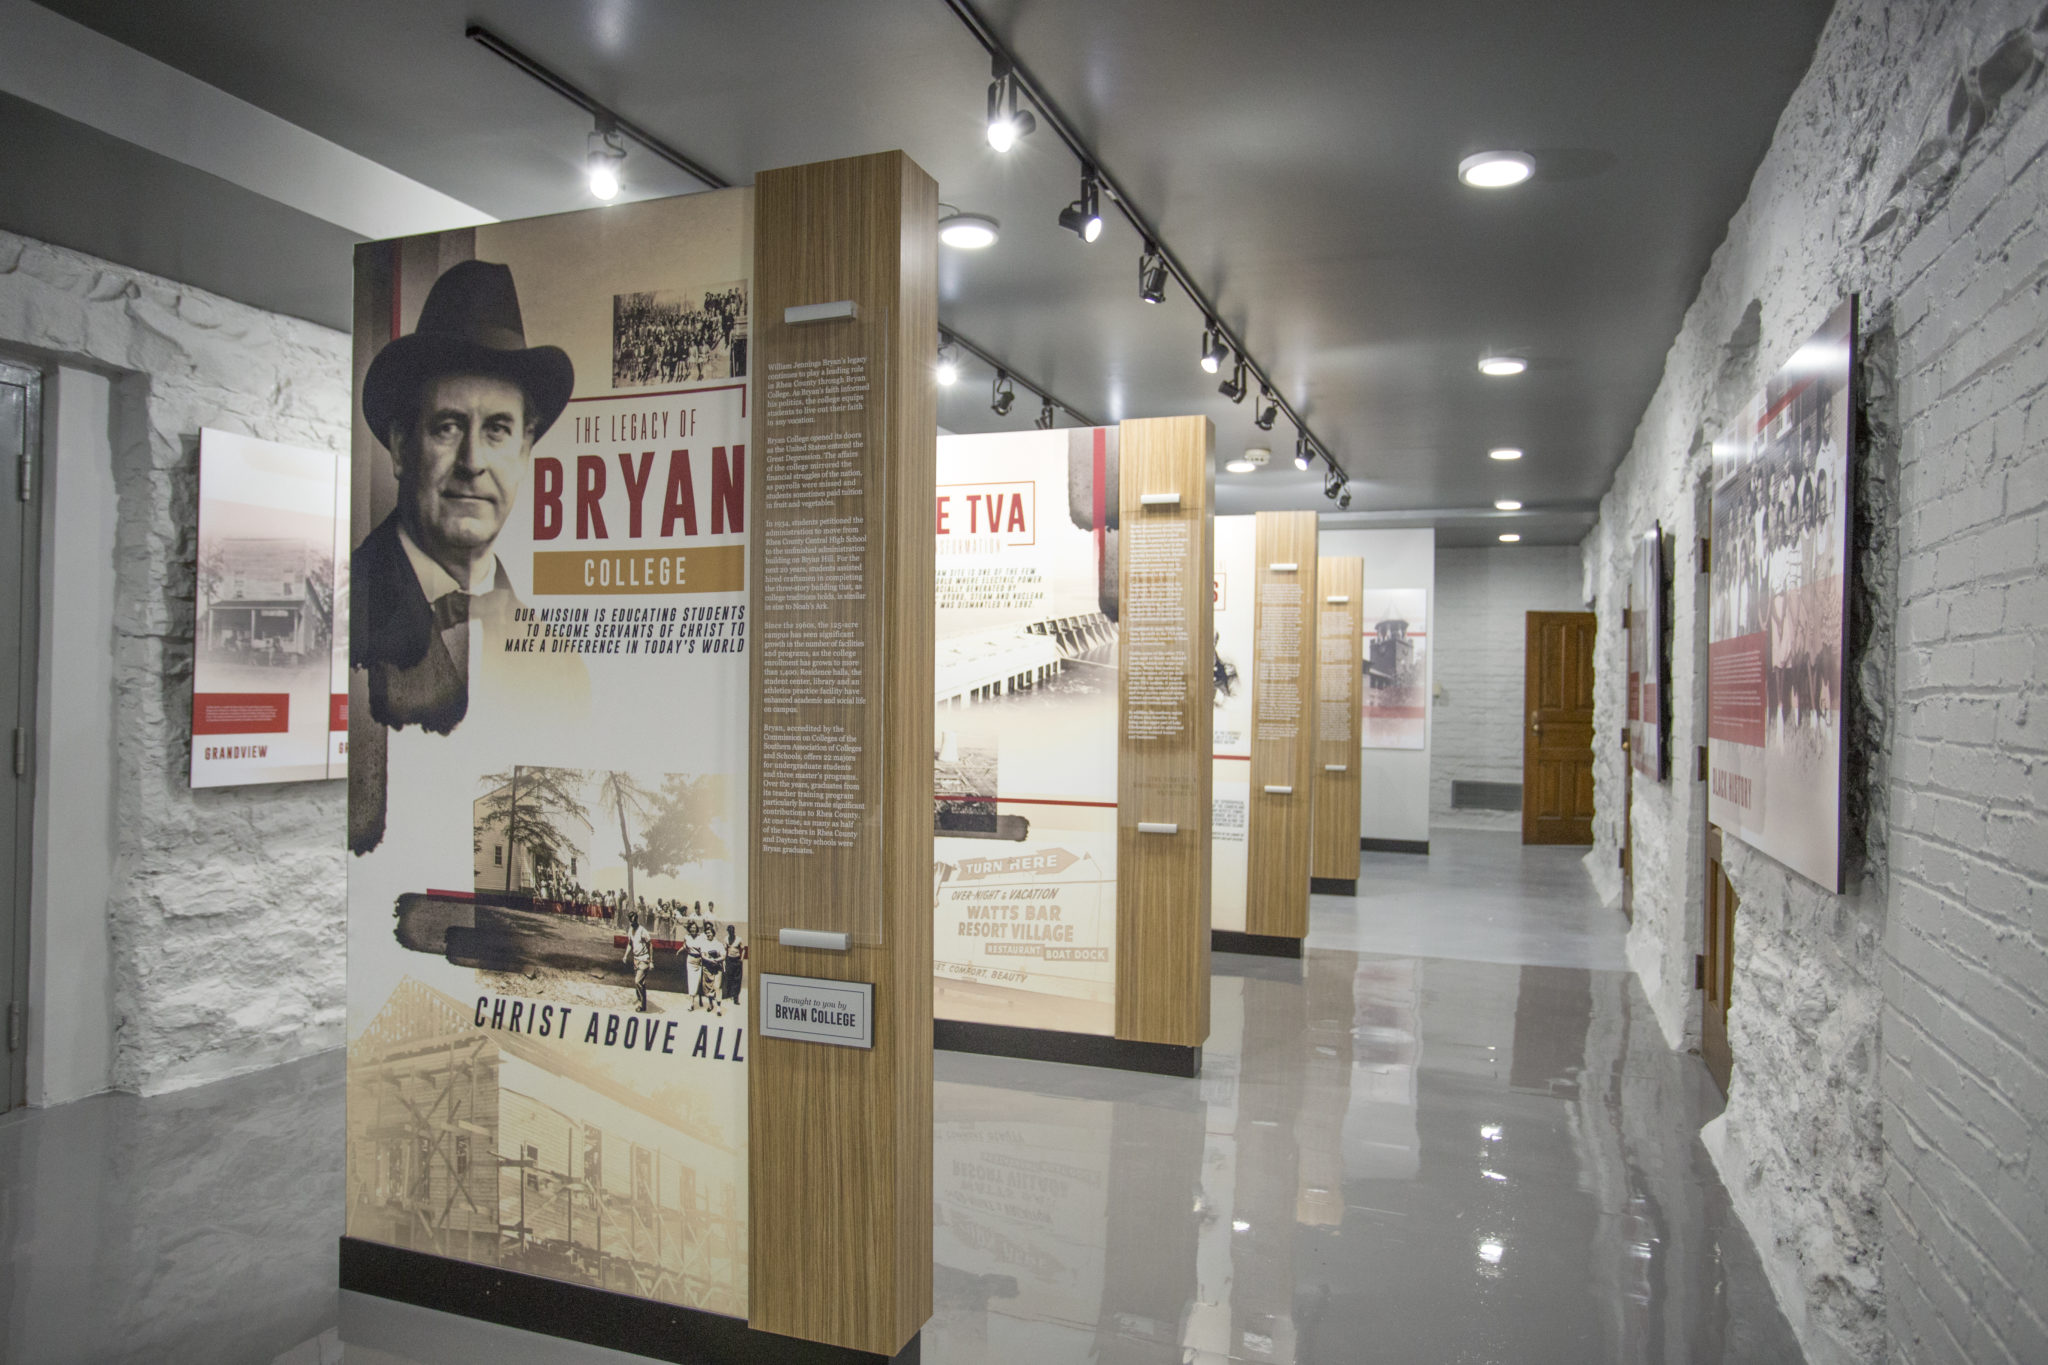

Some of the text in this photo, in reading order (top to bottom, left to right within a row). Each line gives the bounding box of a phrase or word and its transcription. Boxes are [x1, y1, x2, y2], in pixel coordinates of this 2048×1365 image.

[793, 360, 821, 370] Jennings
[823, 358, 846, 367] Bryan's
[848, 356, 866, 365] legacy
[576, 409, 697, 444] THE LEGACY OF
[768, 436, 785, 445] Bryan
[787, 434, 809, 444] College
[810, 433, 832, 443] opened
[787, 463, 808, 472] college
[811, 461, 839, 469] mirrored
[534, 445, 745, 540] BRYAN
[966, 493, 1025, 534] TVA
[584, 557, 686, 586] COLLEGE
[515, 606, 745, 622] OUR MISSION IS EDUCATING STUDENTS
[527, 622, 745, 638] TO BECOME SERVANTS OF CHRIST TO
[505, 638, 745, 654] MAKE A DIFFERENCE IN TODAY'S WORLD
[204, 745, 268, 760] GRANDVIEW
[775, 762, 822, 772] undergraduate
[798, 791, 824, 800] training
[1729, 772, 1752, 810] HISTORY
[966, 855, 1057, 874] TURN HERE
[1009, 888, 1060, 900] VACATION
[967, 905, 1061, 921] WATTS BAR
[958, 922, 1074, 942] RESORT VILLAGE
[988, 944, 1041, 955] RESTAURANT
[1046, 950, 1105, 960] BOAT DOCK
[991, 970, 1028, 983] BEAUTY
[783, 995, 811, 1006] Brought
[838, 1001, 847, 1010] by
[474, 996, 744, 1062] CHRIST ABOVE ALL
